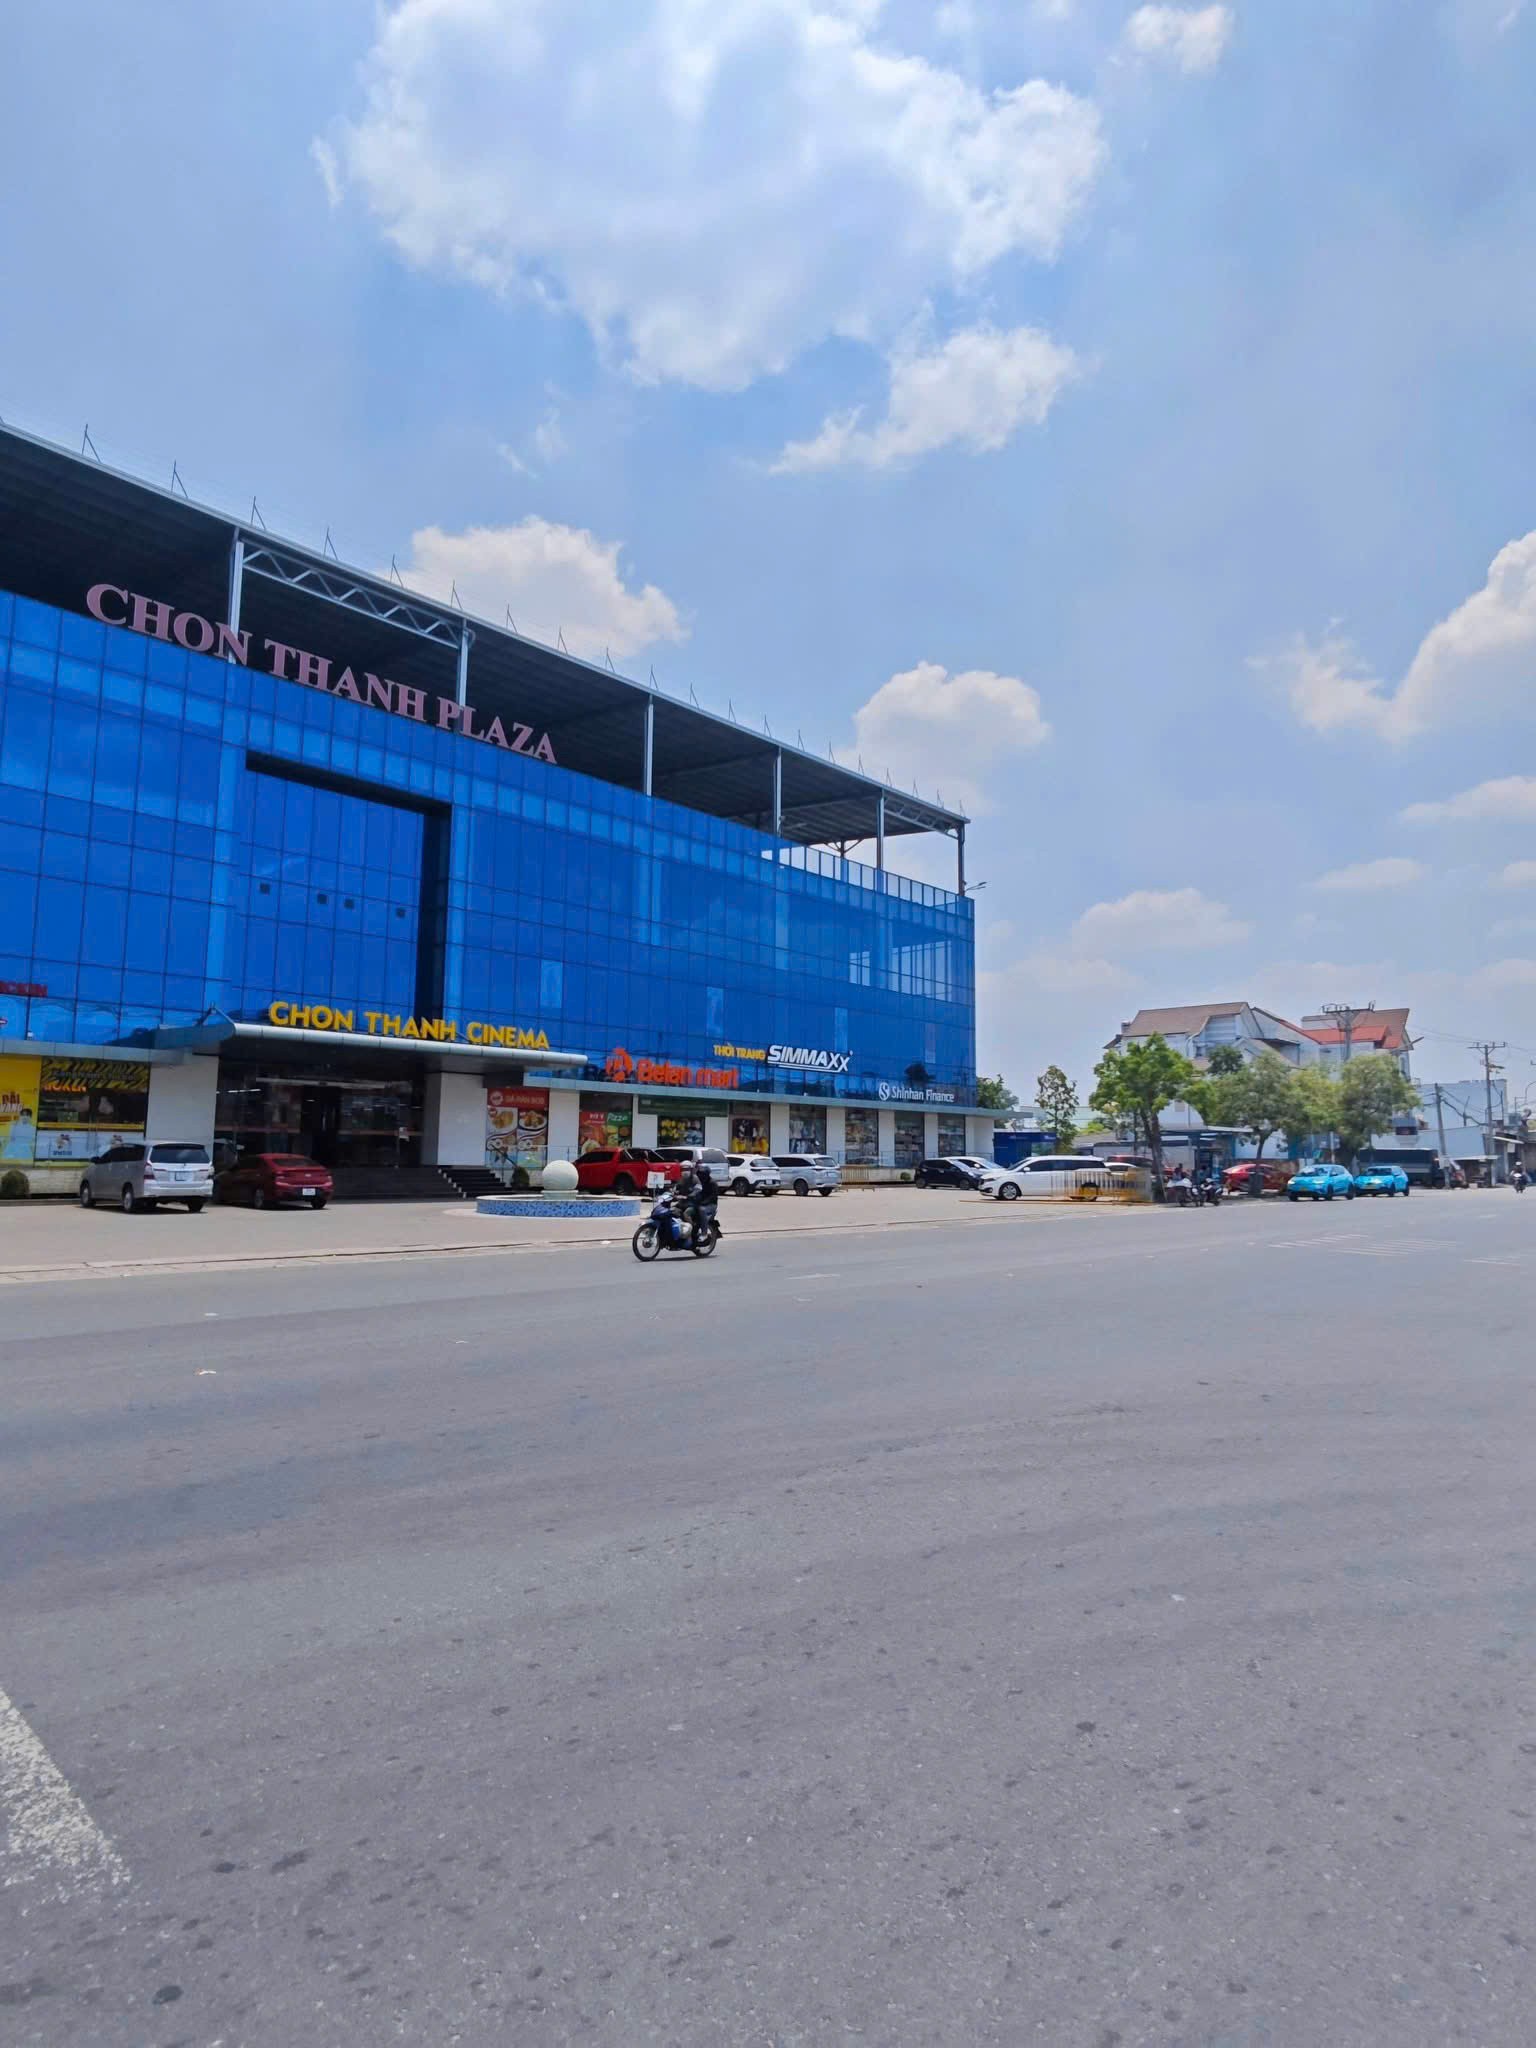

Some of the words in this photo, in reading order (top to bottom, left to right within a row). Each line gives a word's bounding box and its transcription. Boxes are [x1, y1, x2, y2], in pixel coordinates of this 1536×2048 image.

[86, 583, 253, 666] CHON
[264, 638, 428, 722] THANH
[436, 696, 558, 764] PLAZA
[268, 1001, 354, 1032] CHON
[363, 1011, 456, 1041] THANH
[466, 1021, 549, 1050] CINEMA
[736, 1047, 766, 1060] TRANG
[891, 1085, 924, 1101] Shinhan
[926, 1089, 955, 1102] Finance
